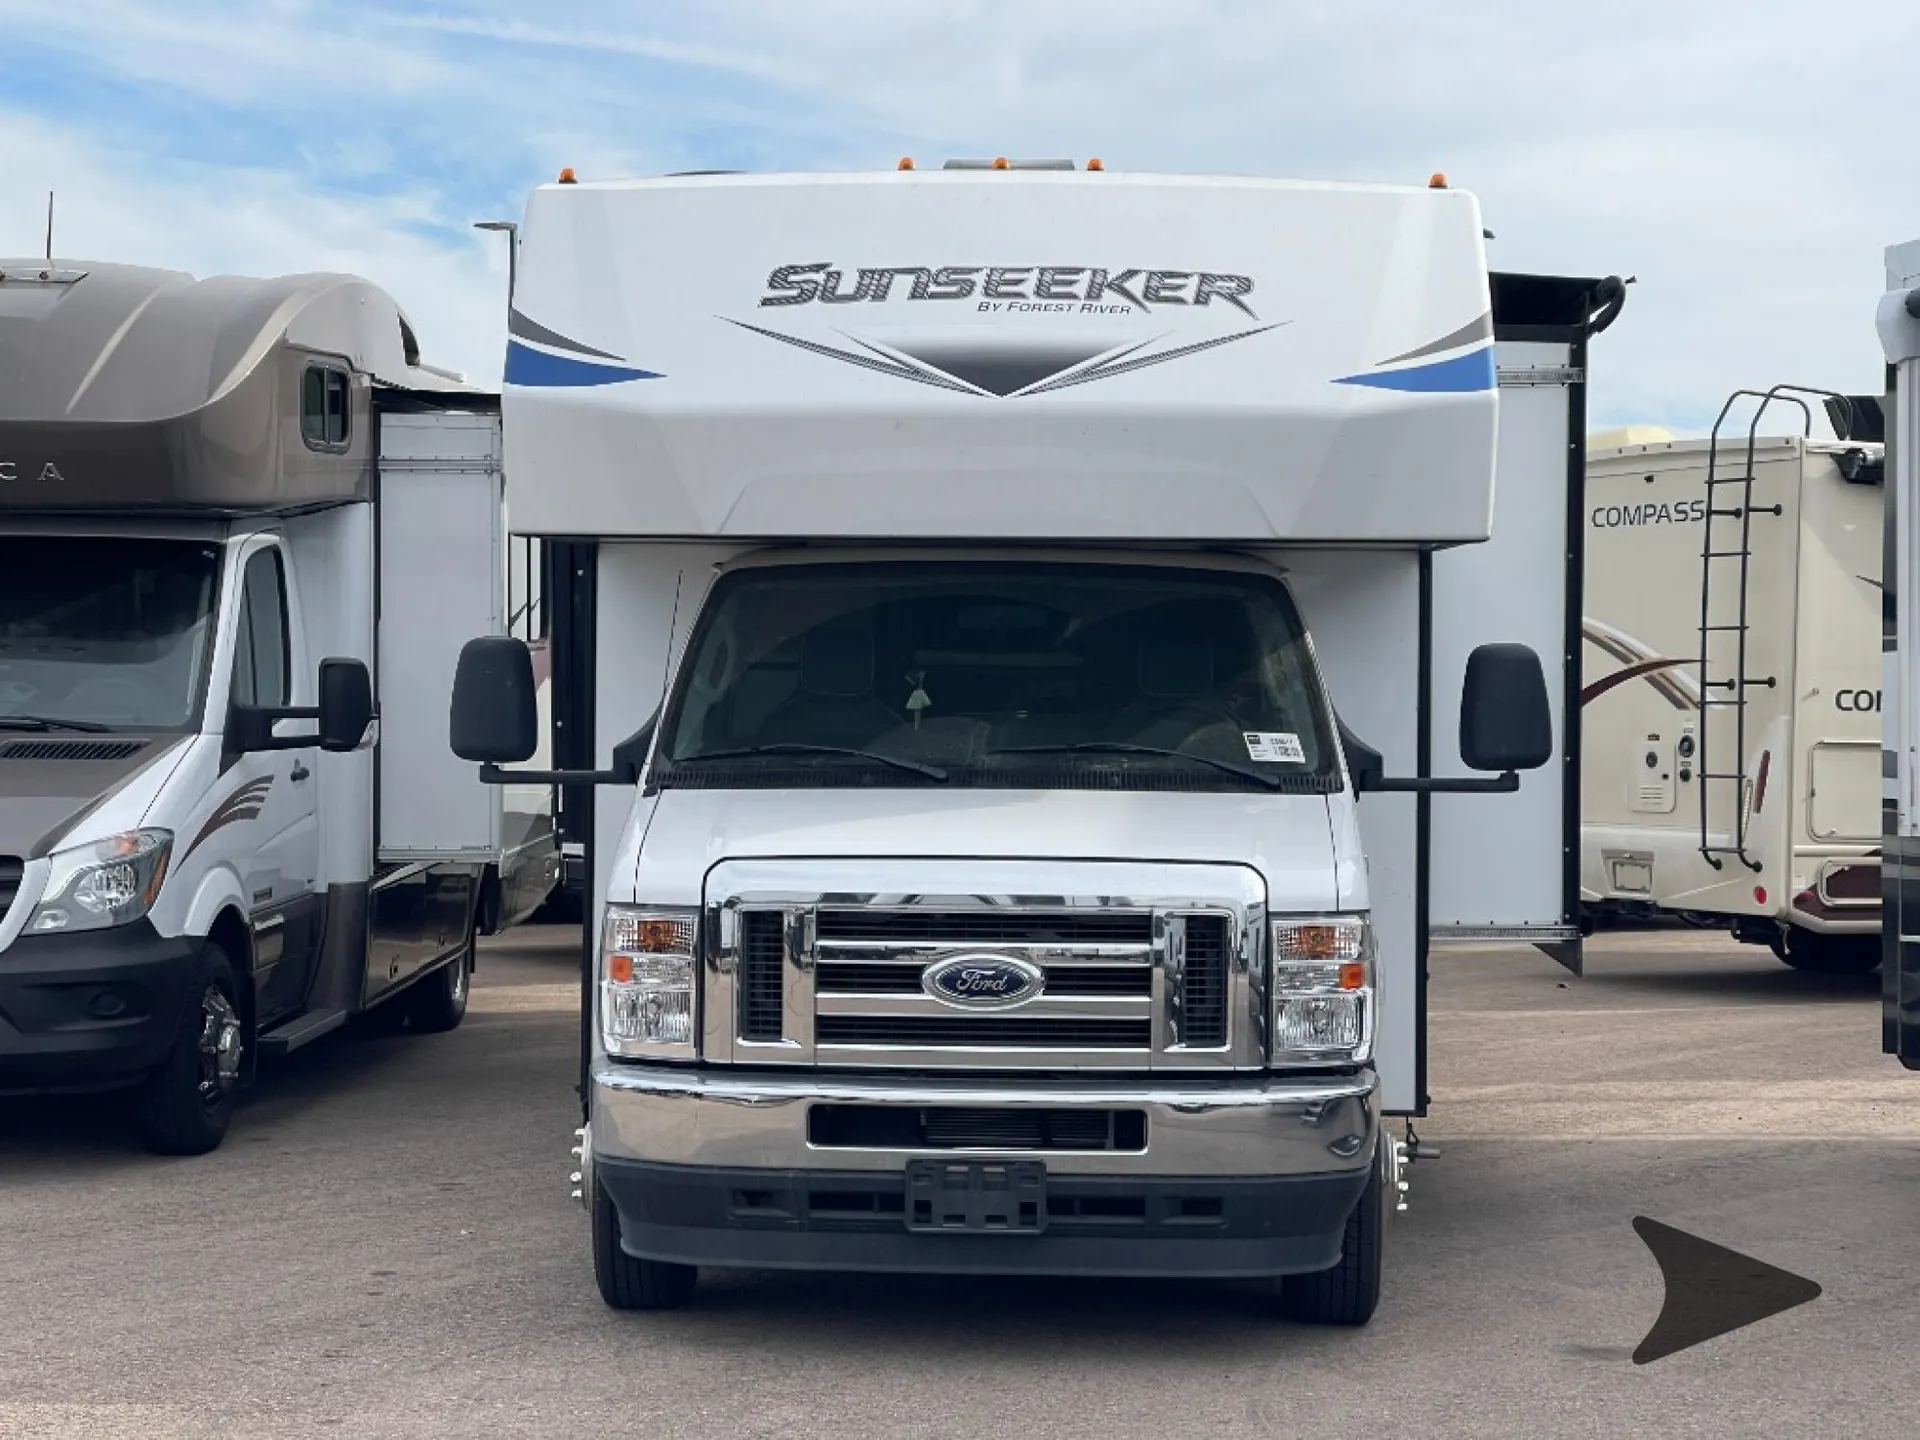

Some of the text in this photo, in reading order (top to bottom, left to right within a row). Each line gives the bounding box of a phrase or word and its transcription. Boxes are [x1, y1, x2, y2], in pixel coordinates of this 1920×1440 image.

[757, 262, 1260, 321] SUNSEEKER
[1007, 301, 1075, 313] FOREST
[1079, 302, 1132, 314] RIVER
[1592, 500, 1705, 528] COMPASS
[1836, 689, 1882, 712] CO
[956, 968, 1008, 991] Ford
